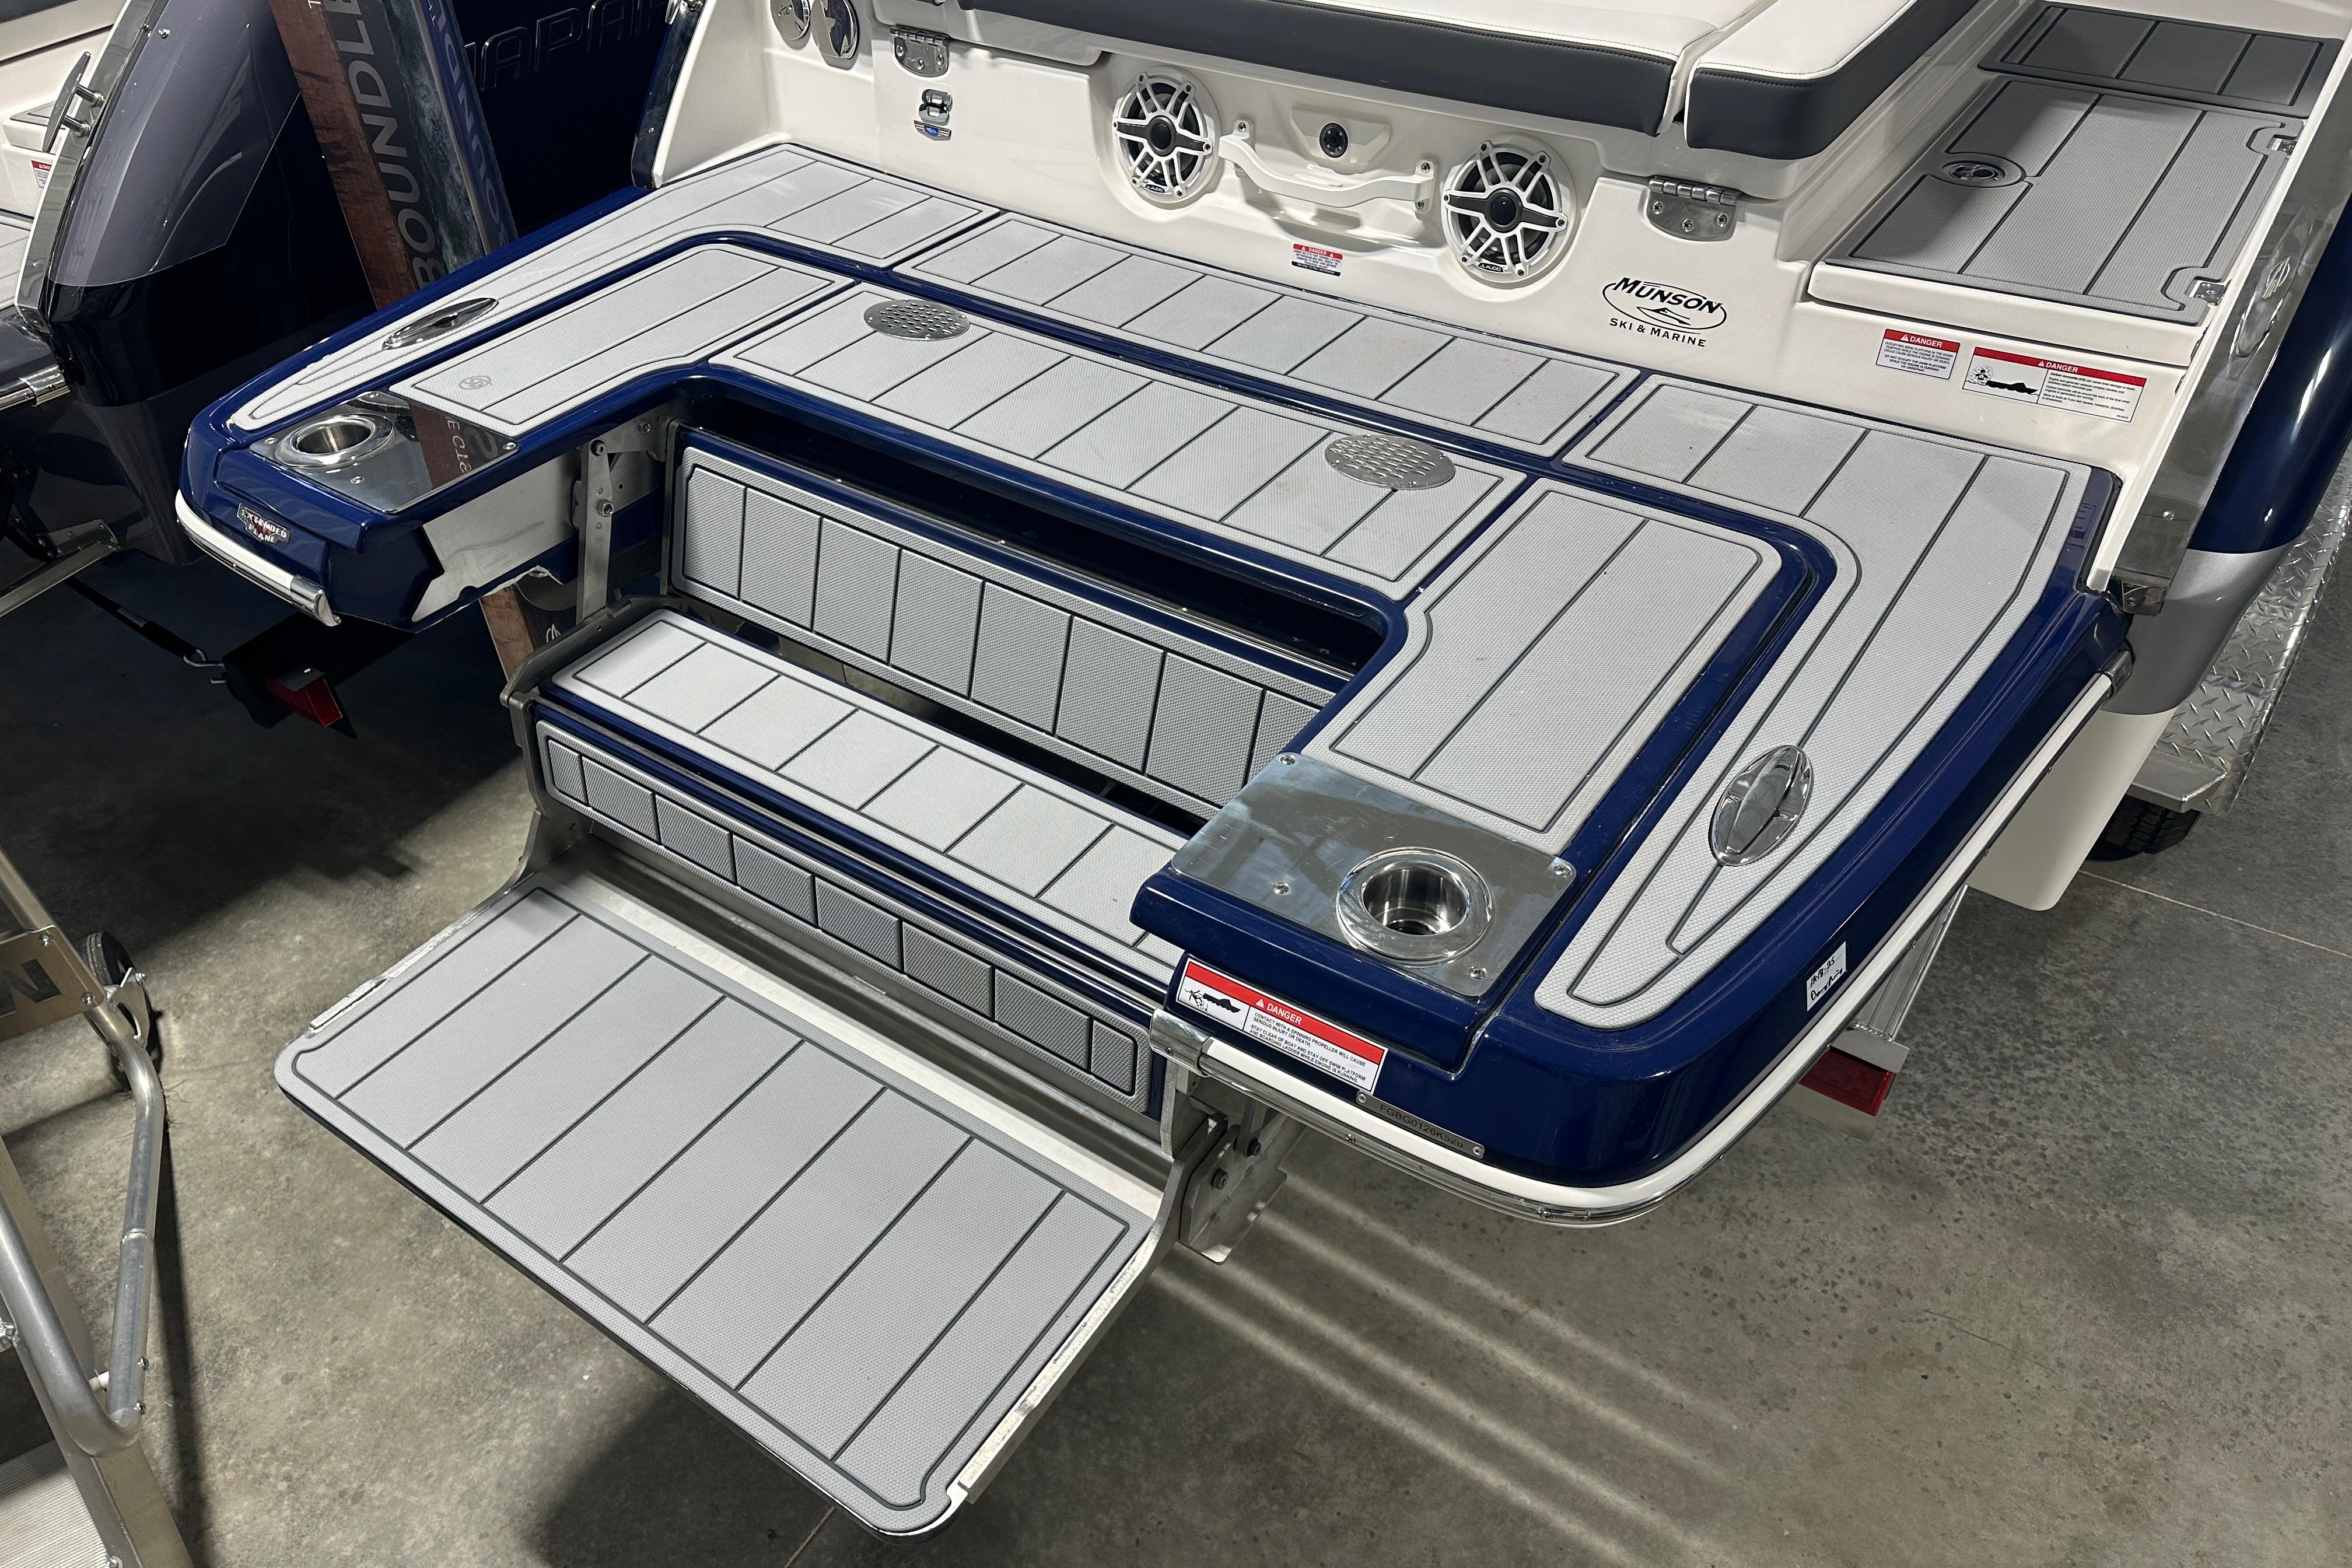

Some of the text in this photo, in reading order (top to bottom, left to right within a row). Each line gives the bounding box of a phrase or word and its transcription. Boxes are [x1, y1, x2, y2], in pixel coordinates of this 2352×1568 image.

[1612, 276, 1723, 314] MUNSON
[1609, 318, 1706, 347] SKI & MARINE
[1910, 335, 1943, 348] DANGER
[2046, 362, 2078, 373] DANGER
[1266, 1002, 1303, 1026] DANGER
[1255, 1012, 1275, 1024] CONTACT
[1312, 1038, 1338, 1054] PROPELLER
[1350, 1056, 1366, 1067] CAUSE
